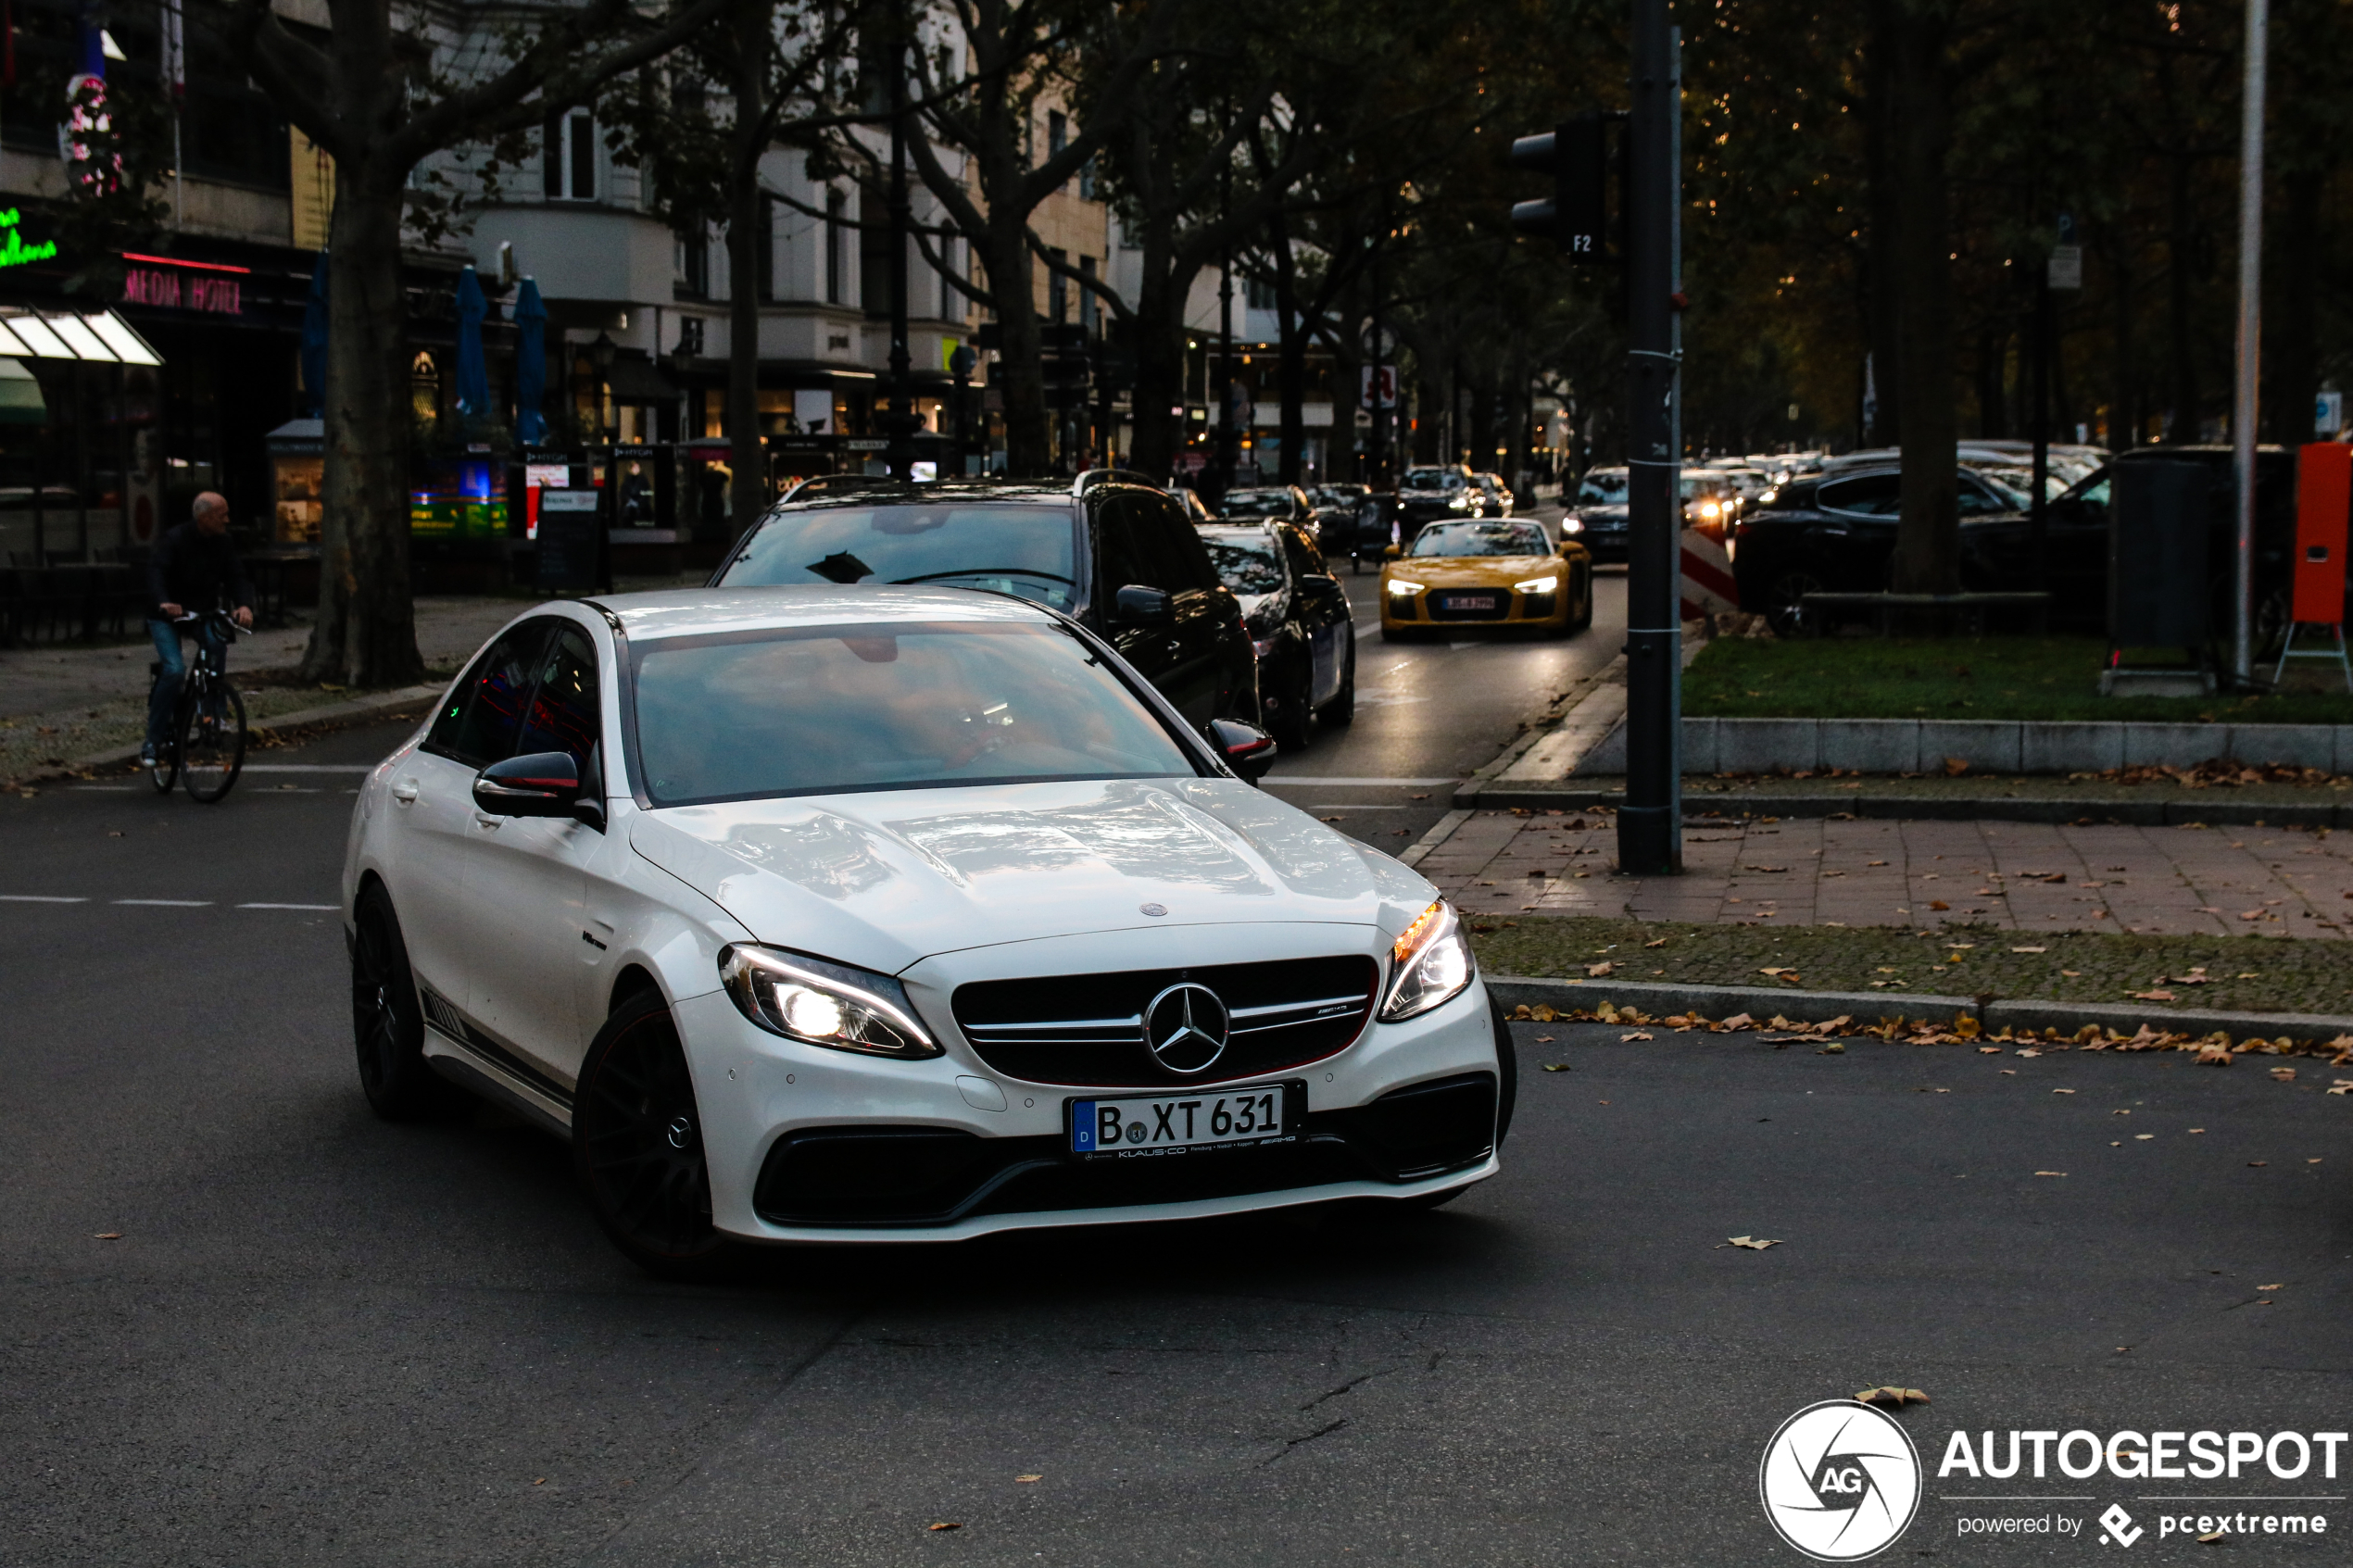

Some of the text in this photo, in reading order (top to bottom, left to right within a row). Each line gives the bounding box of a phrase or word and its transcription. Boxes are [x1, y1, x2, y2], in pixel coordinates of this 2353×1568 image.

[1573, 233, 1592, 252] F2
[124, 268, 243, 315] MEDIA HOTEL
[1098, 1093, 1278, 1145] B XT 631
[1080, 1131, 1089, 1143] D
[1270, 1135, 1296, 1144] AMG
